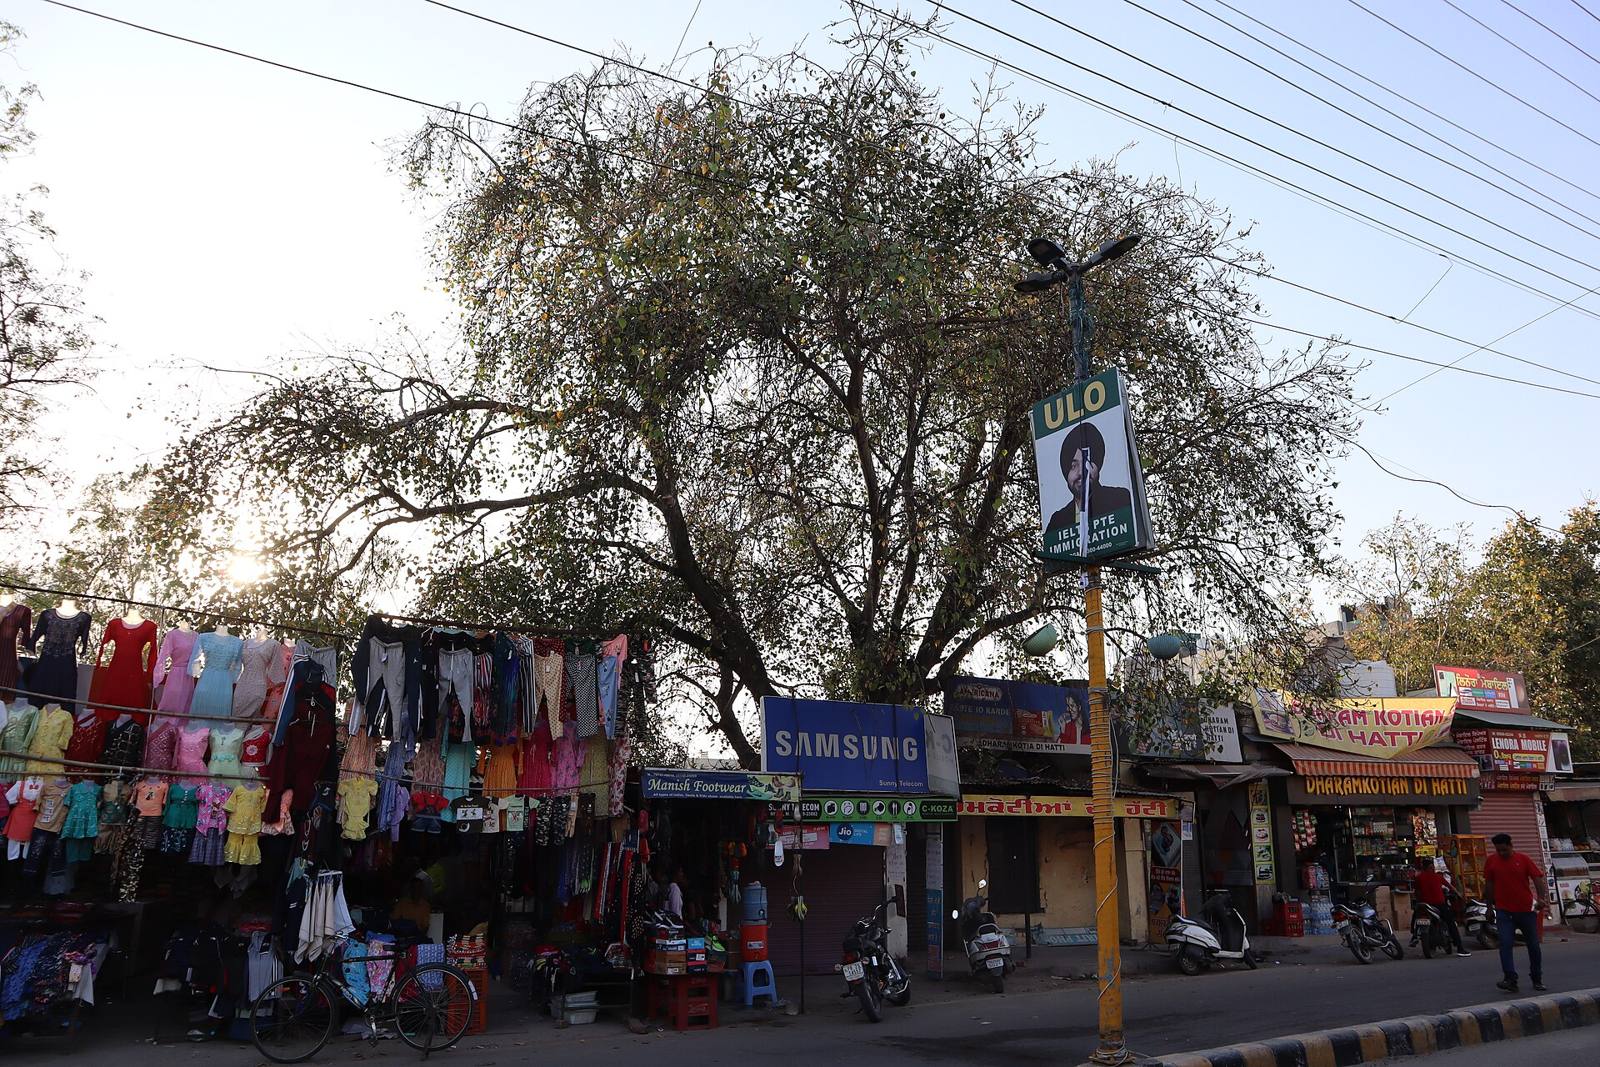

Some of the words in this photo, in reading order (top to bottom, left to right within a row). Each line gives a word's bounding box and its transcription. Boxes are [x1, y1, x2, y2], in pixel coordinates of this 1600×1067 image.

[1043, 380, 1106, 430] ULO
[1058, 525, 1089, 541] IELT
[1093, 514, 1115, 530] PTE
[1373, 710, 1446, 727] KOTIAN
[775, 730, 918, 761] SAMSUNG
[1044, 743, 1066, 751] HATTI
[1348, 731, 1423, 747] HATTI
[1521, 739, 1547, 752] MOBILE
[648, 778, 691, 791] Manish
[693, 780, 746, 793] Footwear
[879, 779, 897, 788] Sunny
[898, 780, 924, 788] Telecom
[1306, 777, 1409, 796] DHARAMKOTIAN
[1414, 778, 1428, 795] DI
[1432, 778, 1468, 796] HATTI
[838, 826, 852, 837] Jio
